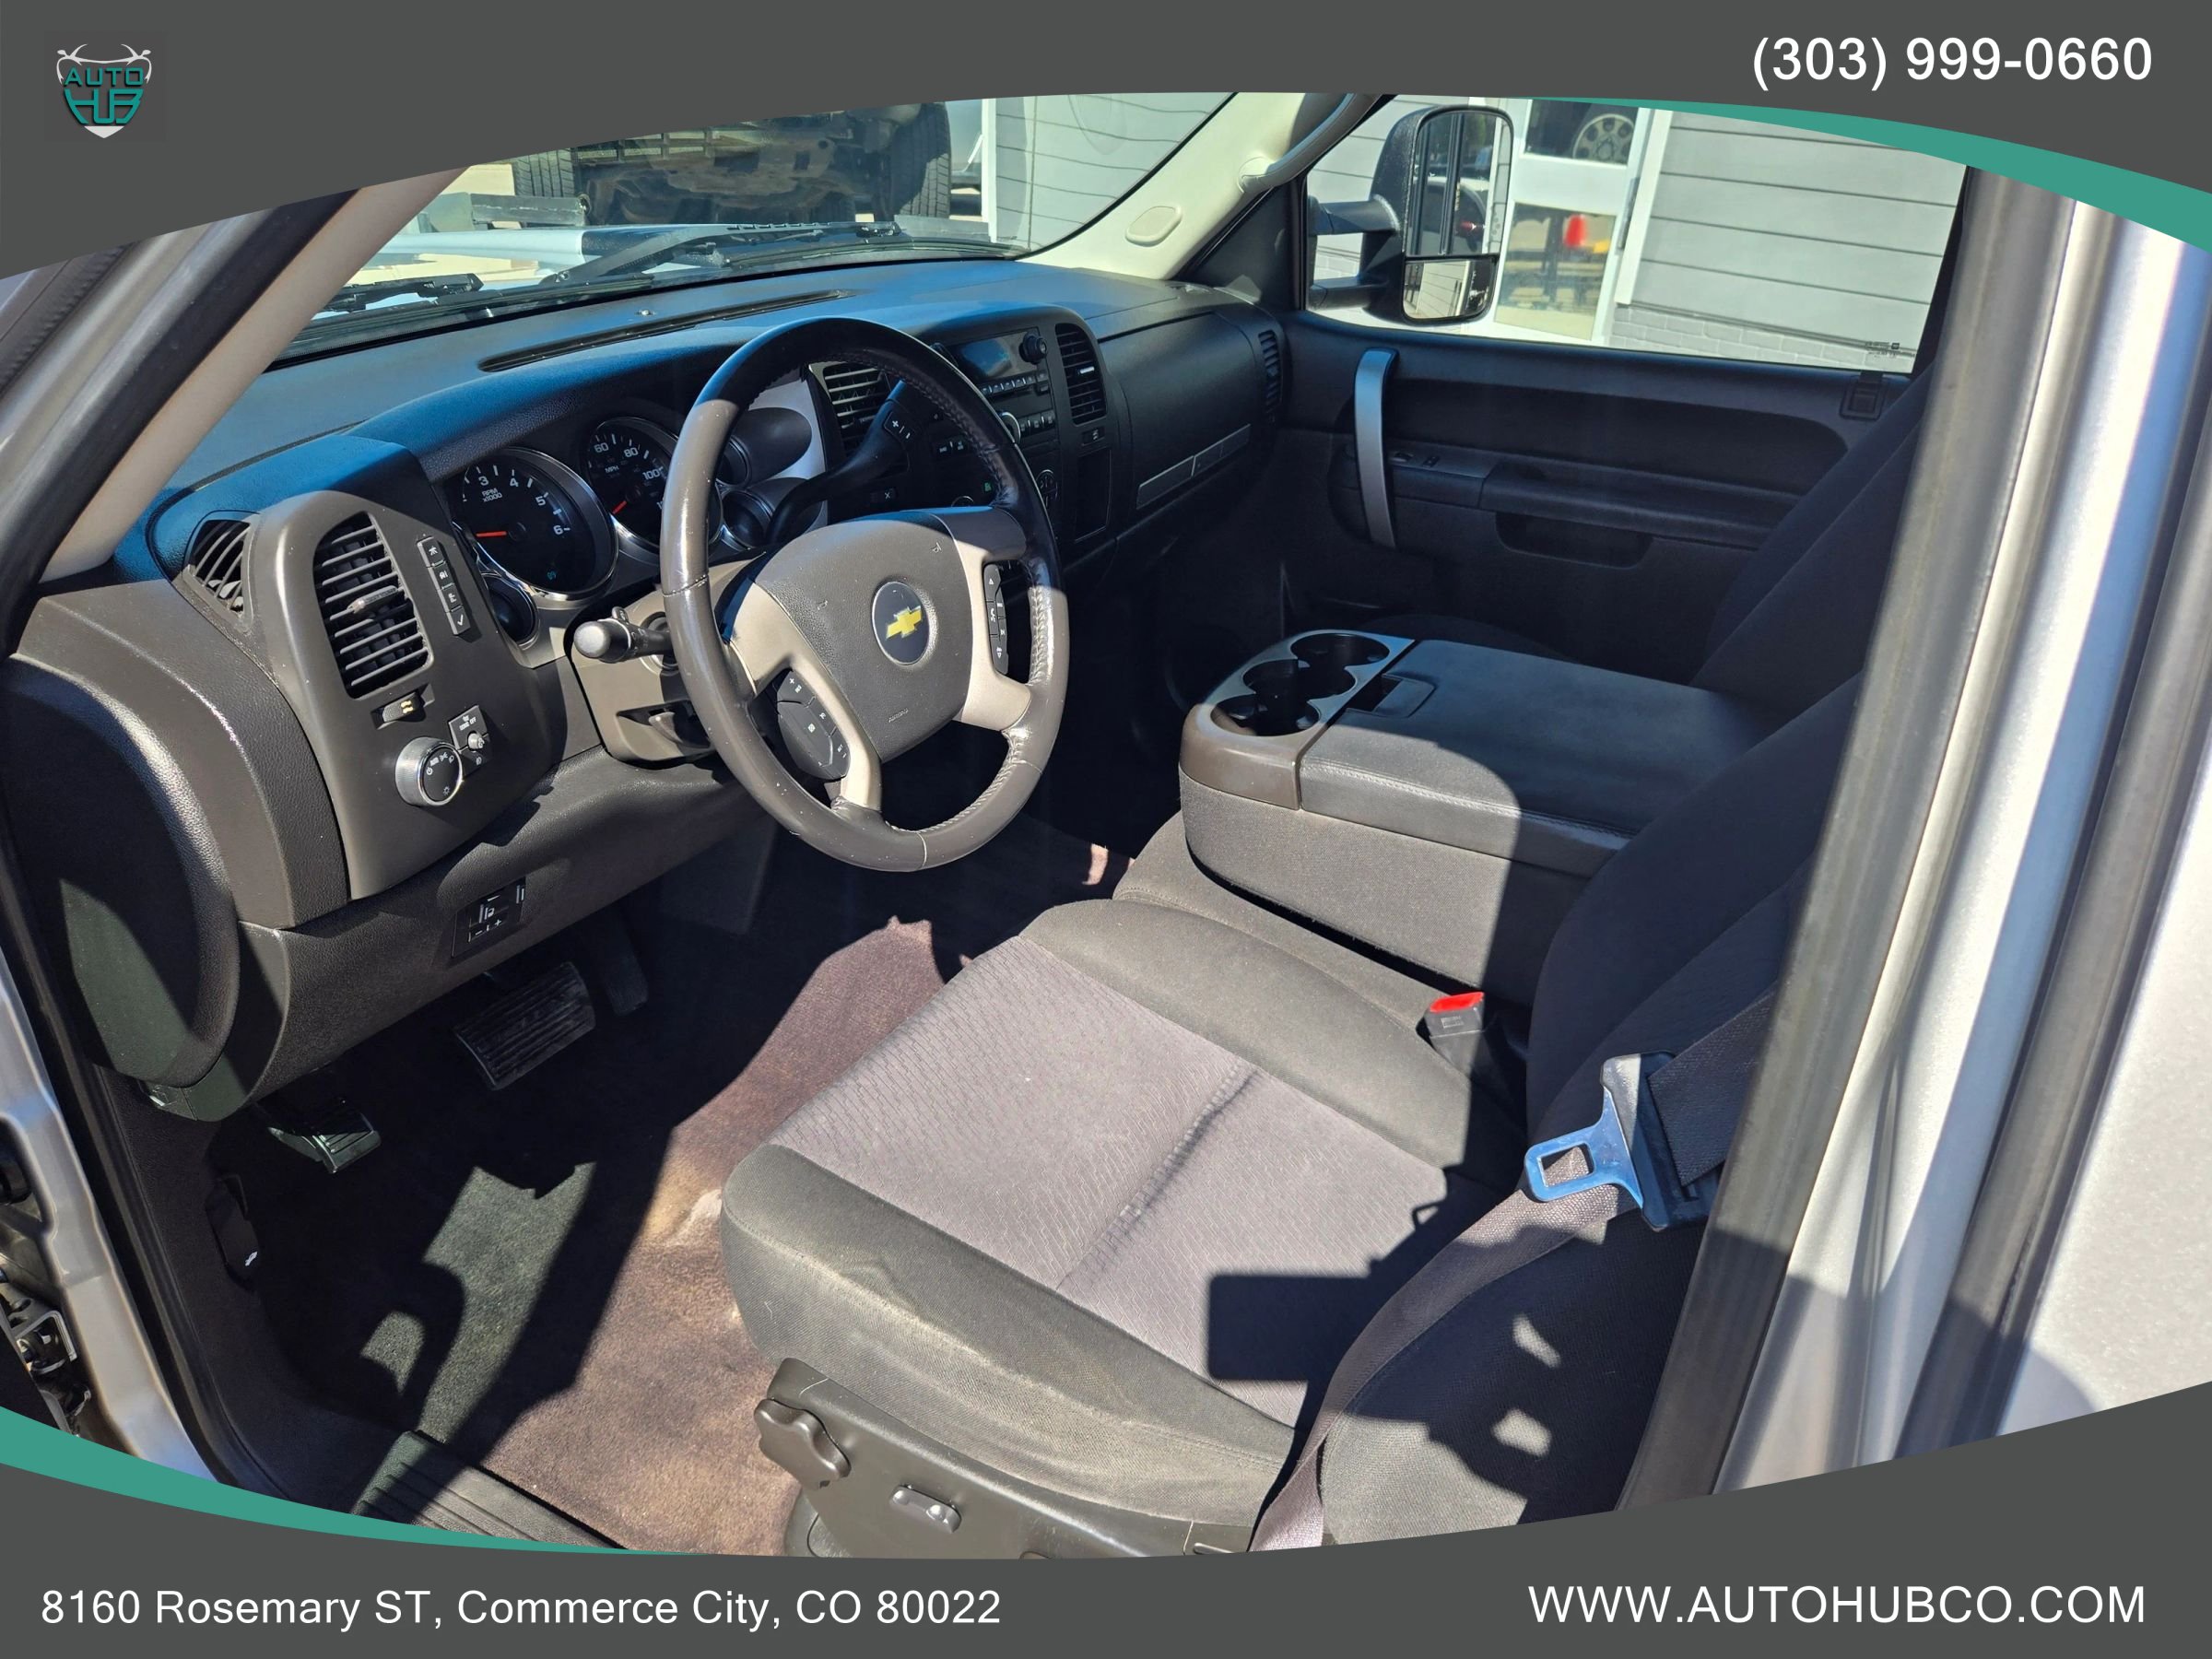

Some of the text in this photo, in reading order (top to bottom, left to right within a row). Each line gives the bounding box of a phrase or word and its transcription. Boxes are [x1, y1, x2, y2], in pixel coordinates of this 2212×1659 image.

[594, 441, 609, 453] 60
[623, 447, 639, 458] 80
[605, 465, 619, 474] MPH
[642, 469, 660, 480] 100
[478, 476, 489, 487] 3
[509, 477, 519, 488] 4
[481, 488, 499, 498] RPM
[535, 495, 547, 506] 5
[553, 524, 564, 535] 6
